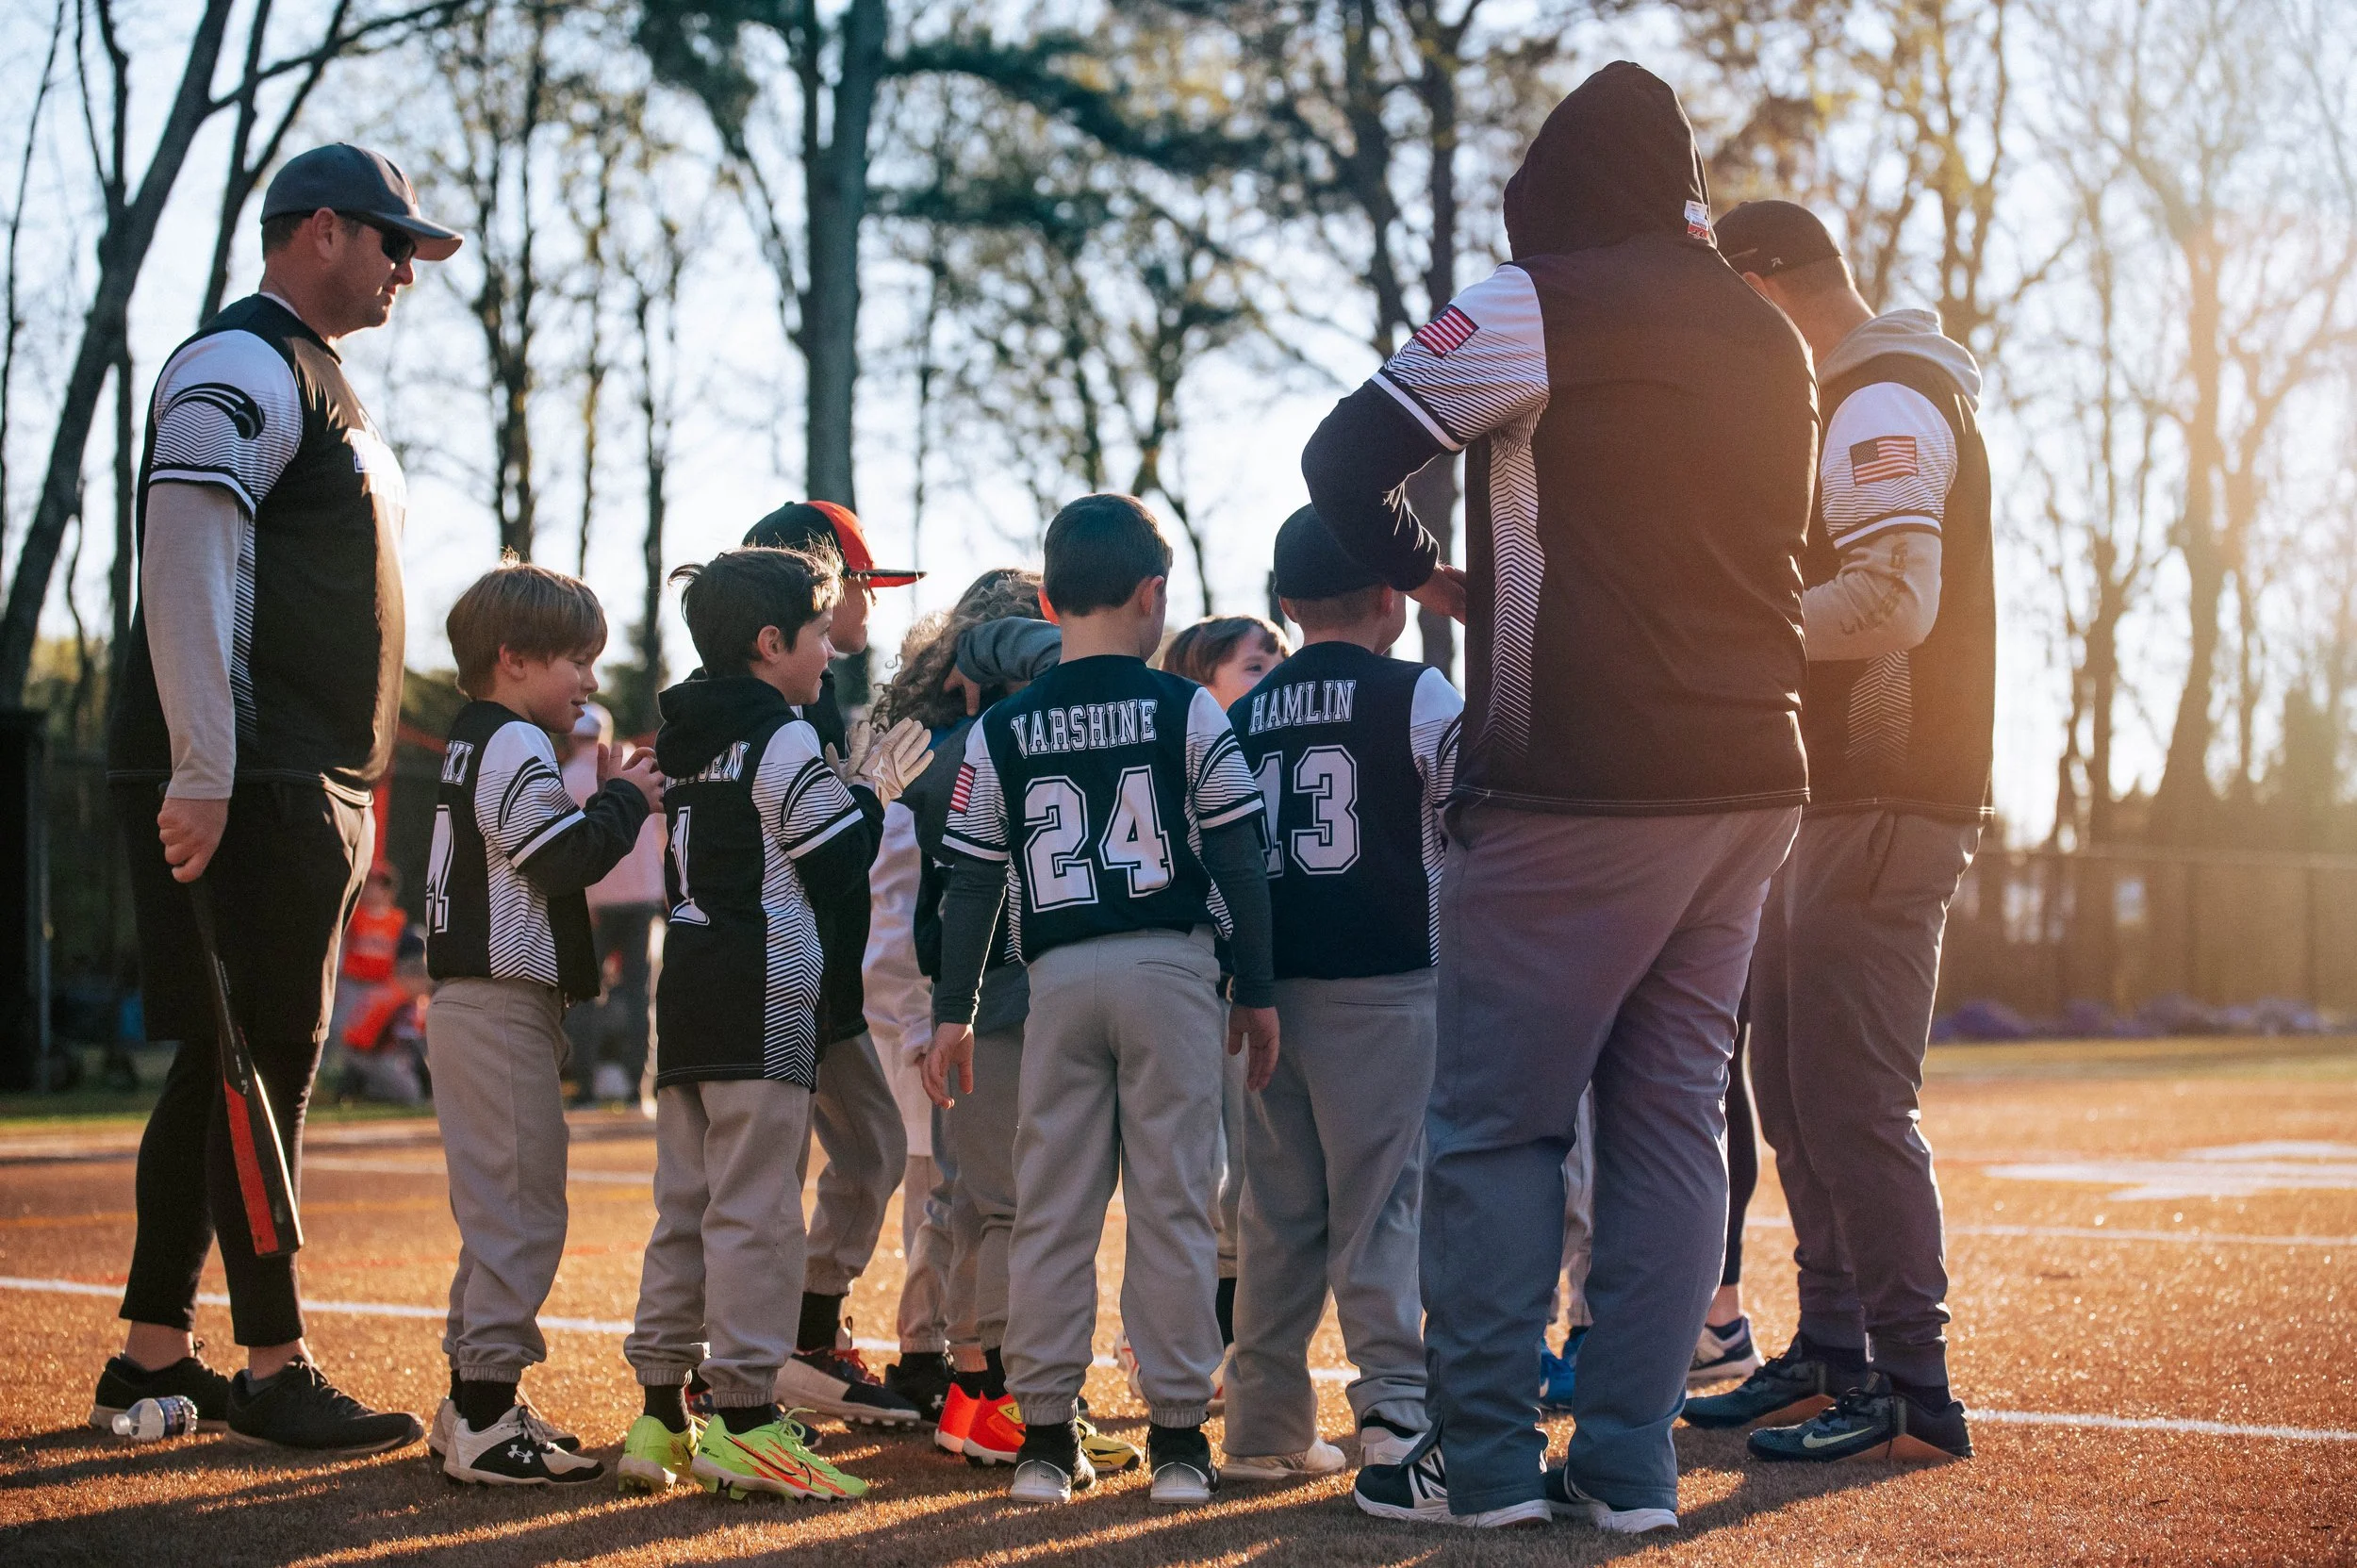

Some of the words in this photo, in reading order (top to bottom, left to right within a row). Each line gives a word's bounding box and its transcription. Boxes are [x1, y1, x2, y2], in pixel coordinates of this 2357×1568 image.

[1011, 699, 1158, 759] VARSHINE
[1248, 680, 1356, 734] HAMLIN
[1024, 764, 1175, 914] 24
[1252, 744, 1360, 879] 13
